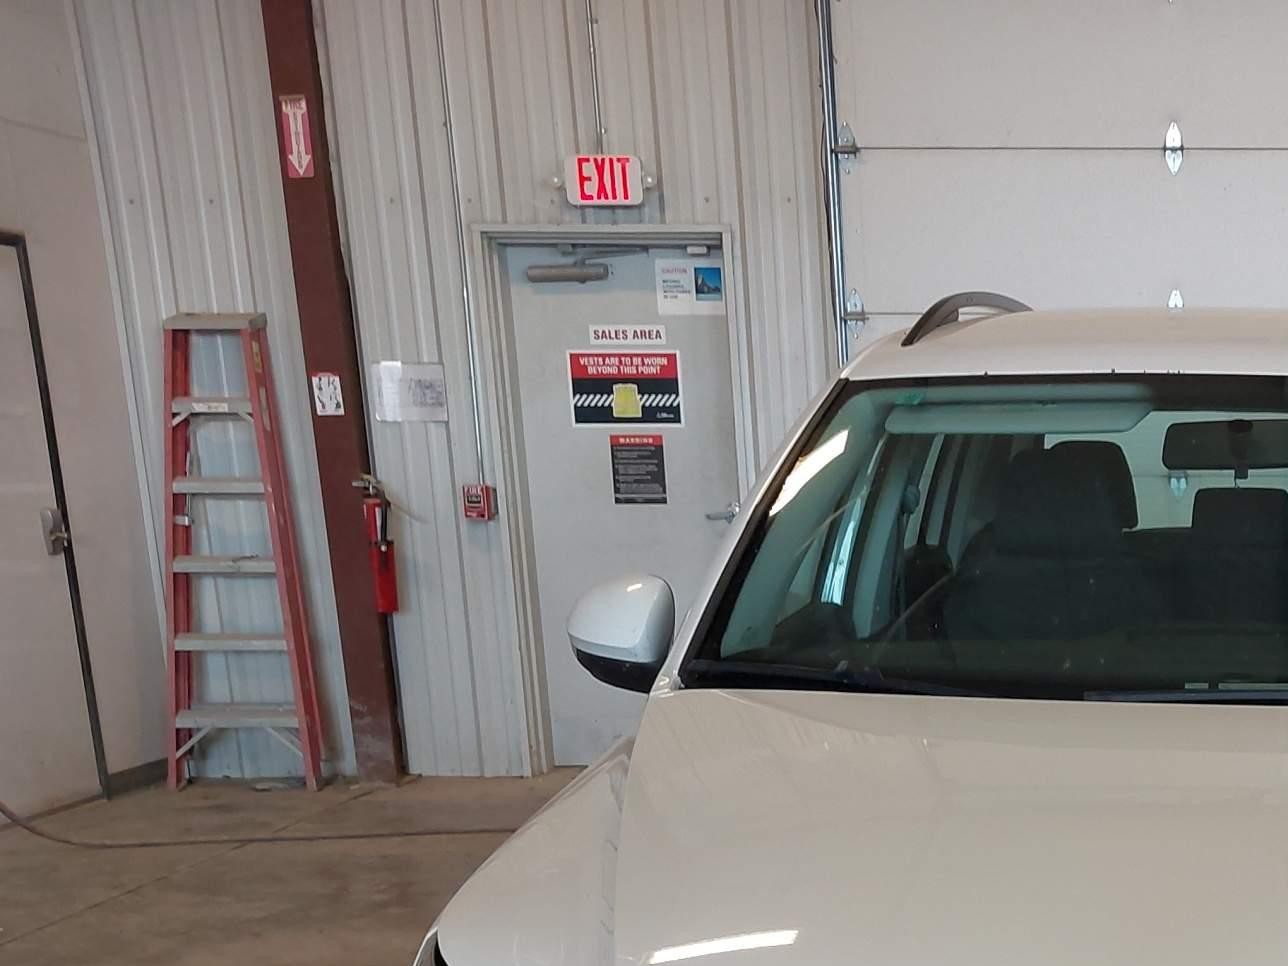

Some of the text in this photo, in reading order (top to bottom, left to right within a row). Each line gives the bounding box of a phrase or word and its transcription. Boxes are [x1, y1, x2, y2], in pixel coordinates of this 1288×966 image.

[576, 157, 631, 201] EXIT
[593, 329, 663, 341] SALES AREA
[579, 357, 668, 366] VESTS ARE TO BE WORN
[587, 366, 661, 374] BEYOND THIS POINT
